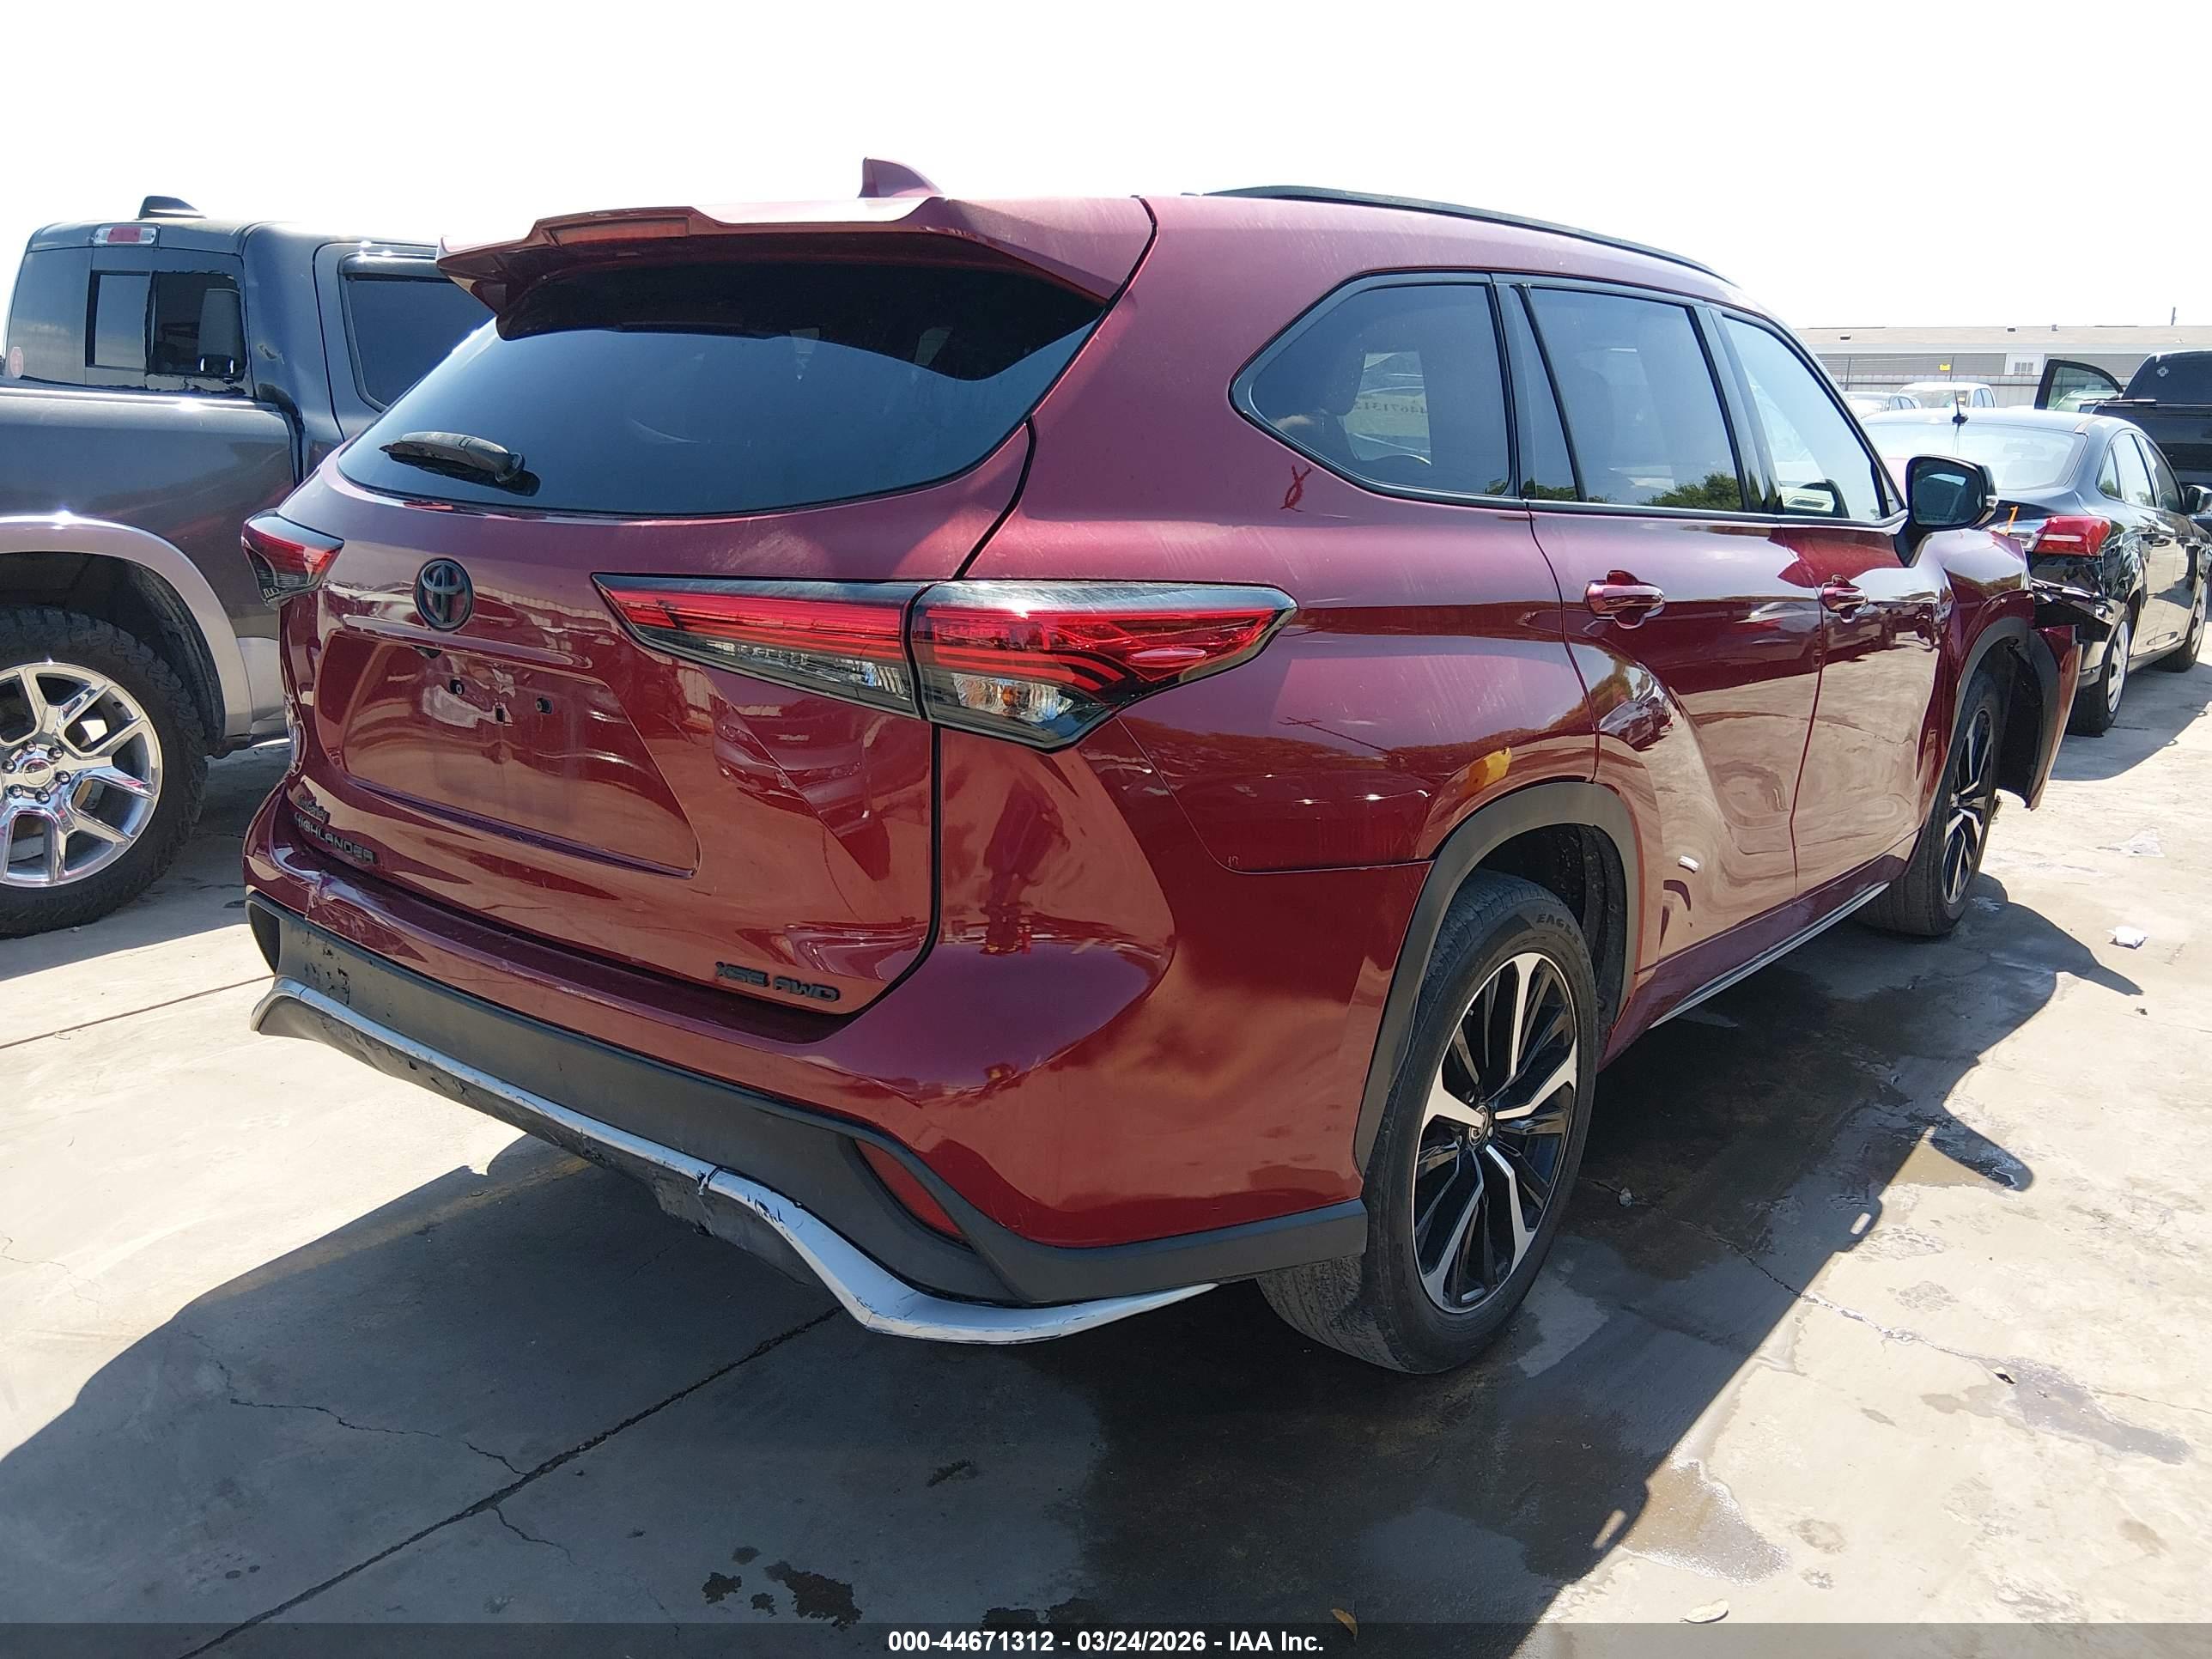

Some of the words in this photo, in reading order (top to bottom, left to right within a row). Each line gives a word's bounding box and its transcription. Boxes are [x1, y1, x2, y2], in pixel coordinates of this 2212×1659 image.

[294, 811, 376, 864] HIGHLANDER
[715, 961, 769, 987] XSE
[773, 975, 841, 1002] AWD
